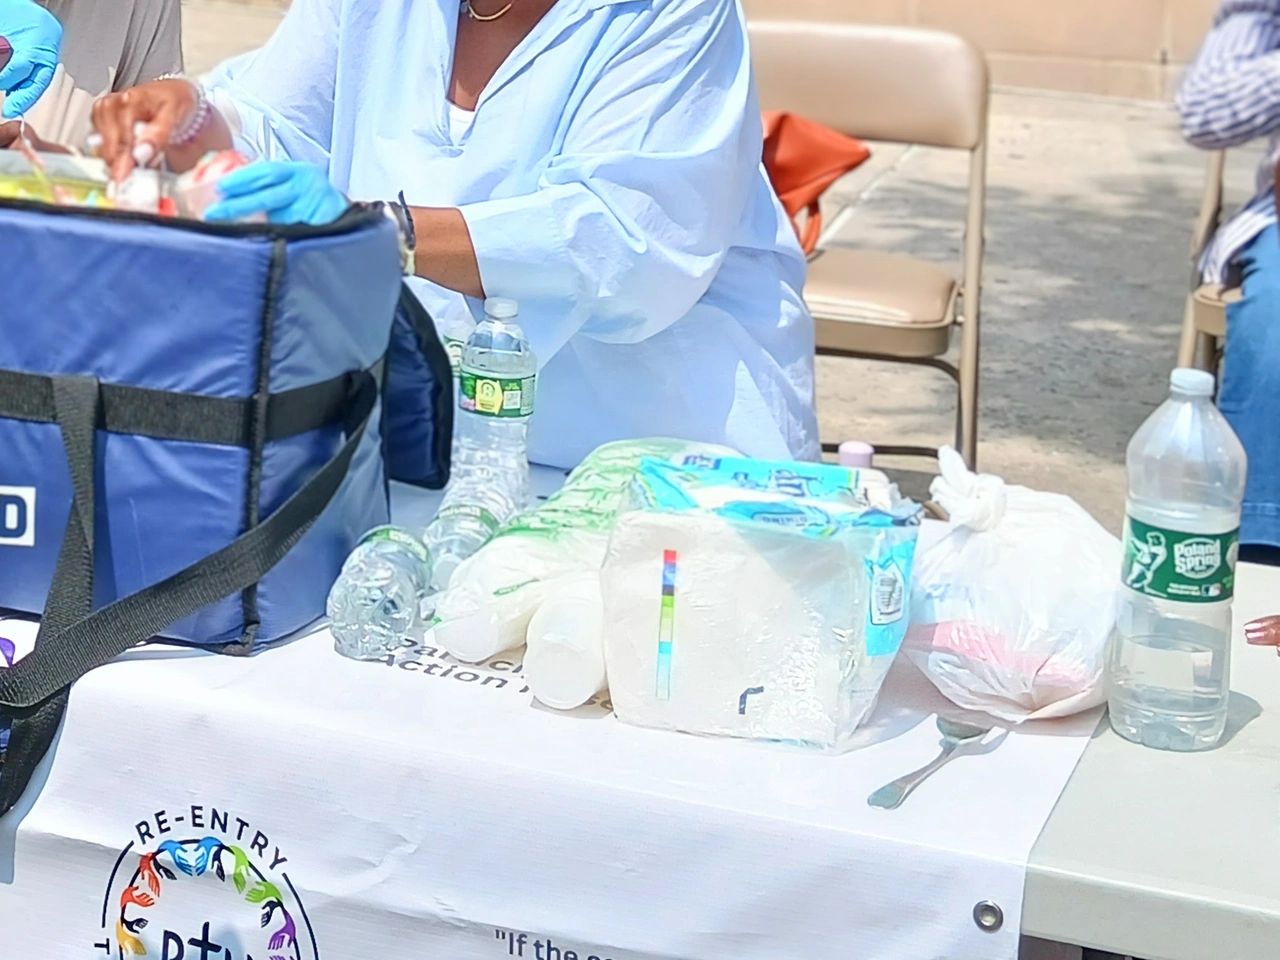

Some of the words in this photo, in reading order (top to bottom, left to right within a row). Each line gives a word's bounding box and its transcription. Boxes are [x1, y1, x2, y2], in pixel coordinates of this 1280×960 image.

[375, 653, 508, 689] Action
[135, 805, 288, 871] RE-ENTRY
[495, 929, 527, 957] "If
[533, 939, 578, 960] the
